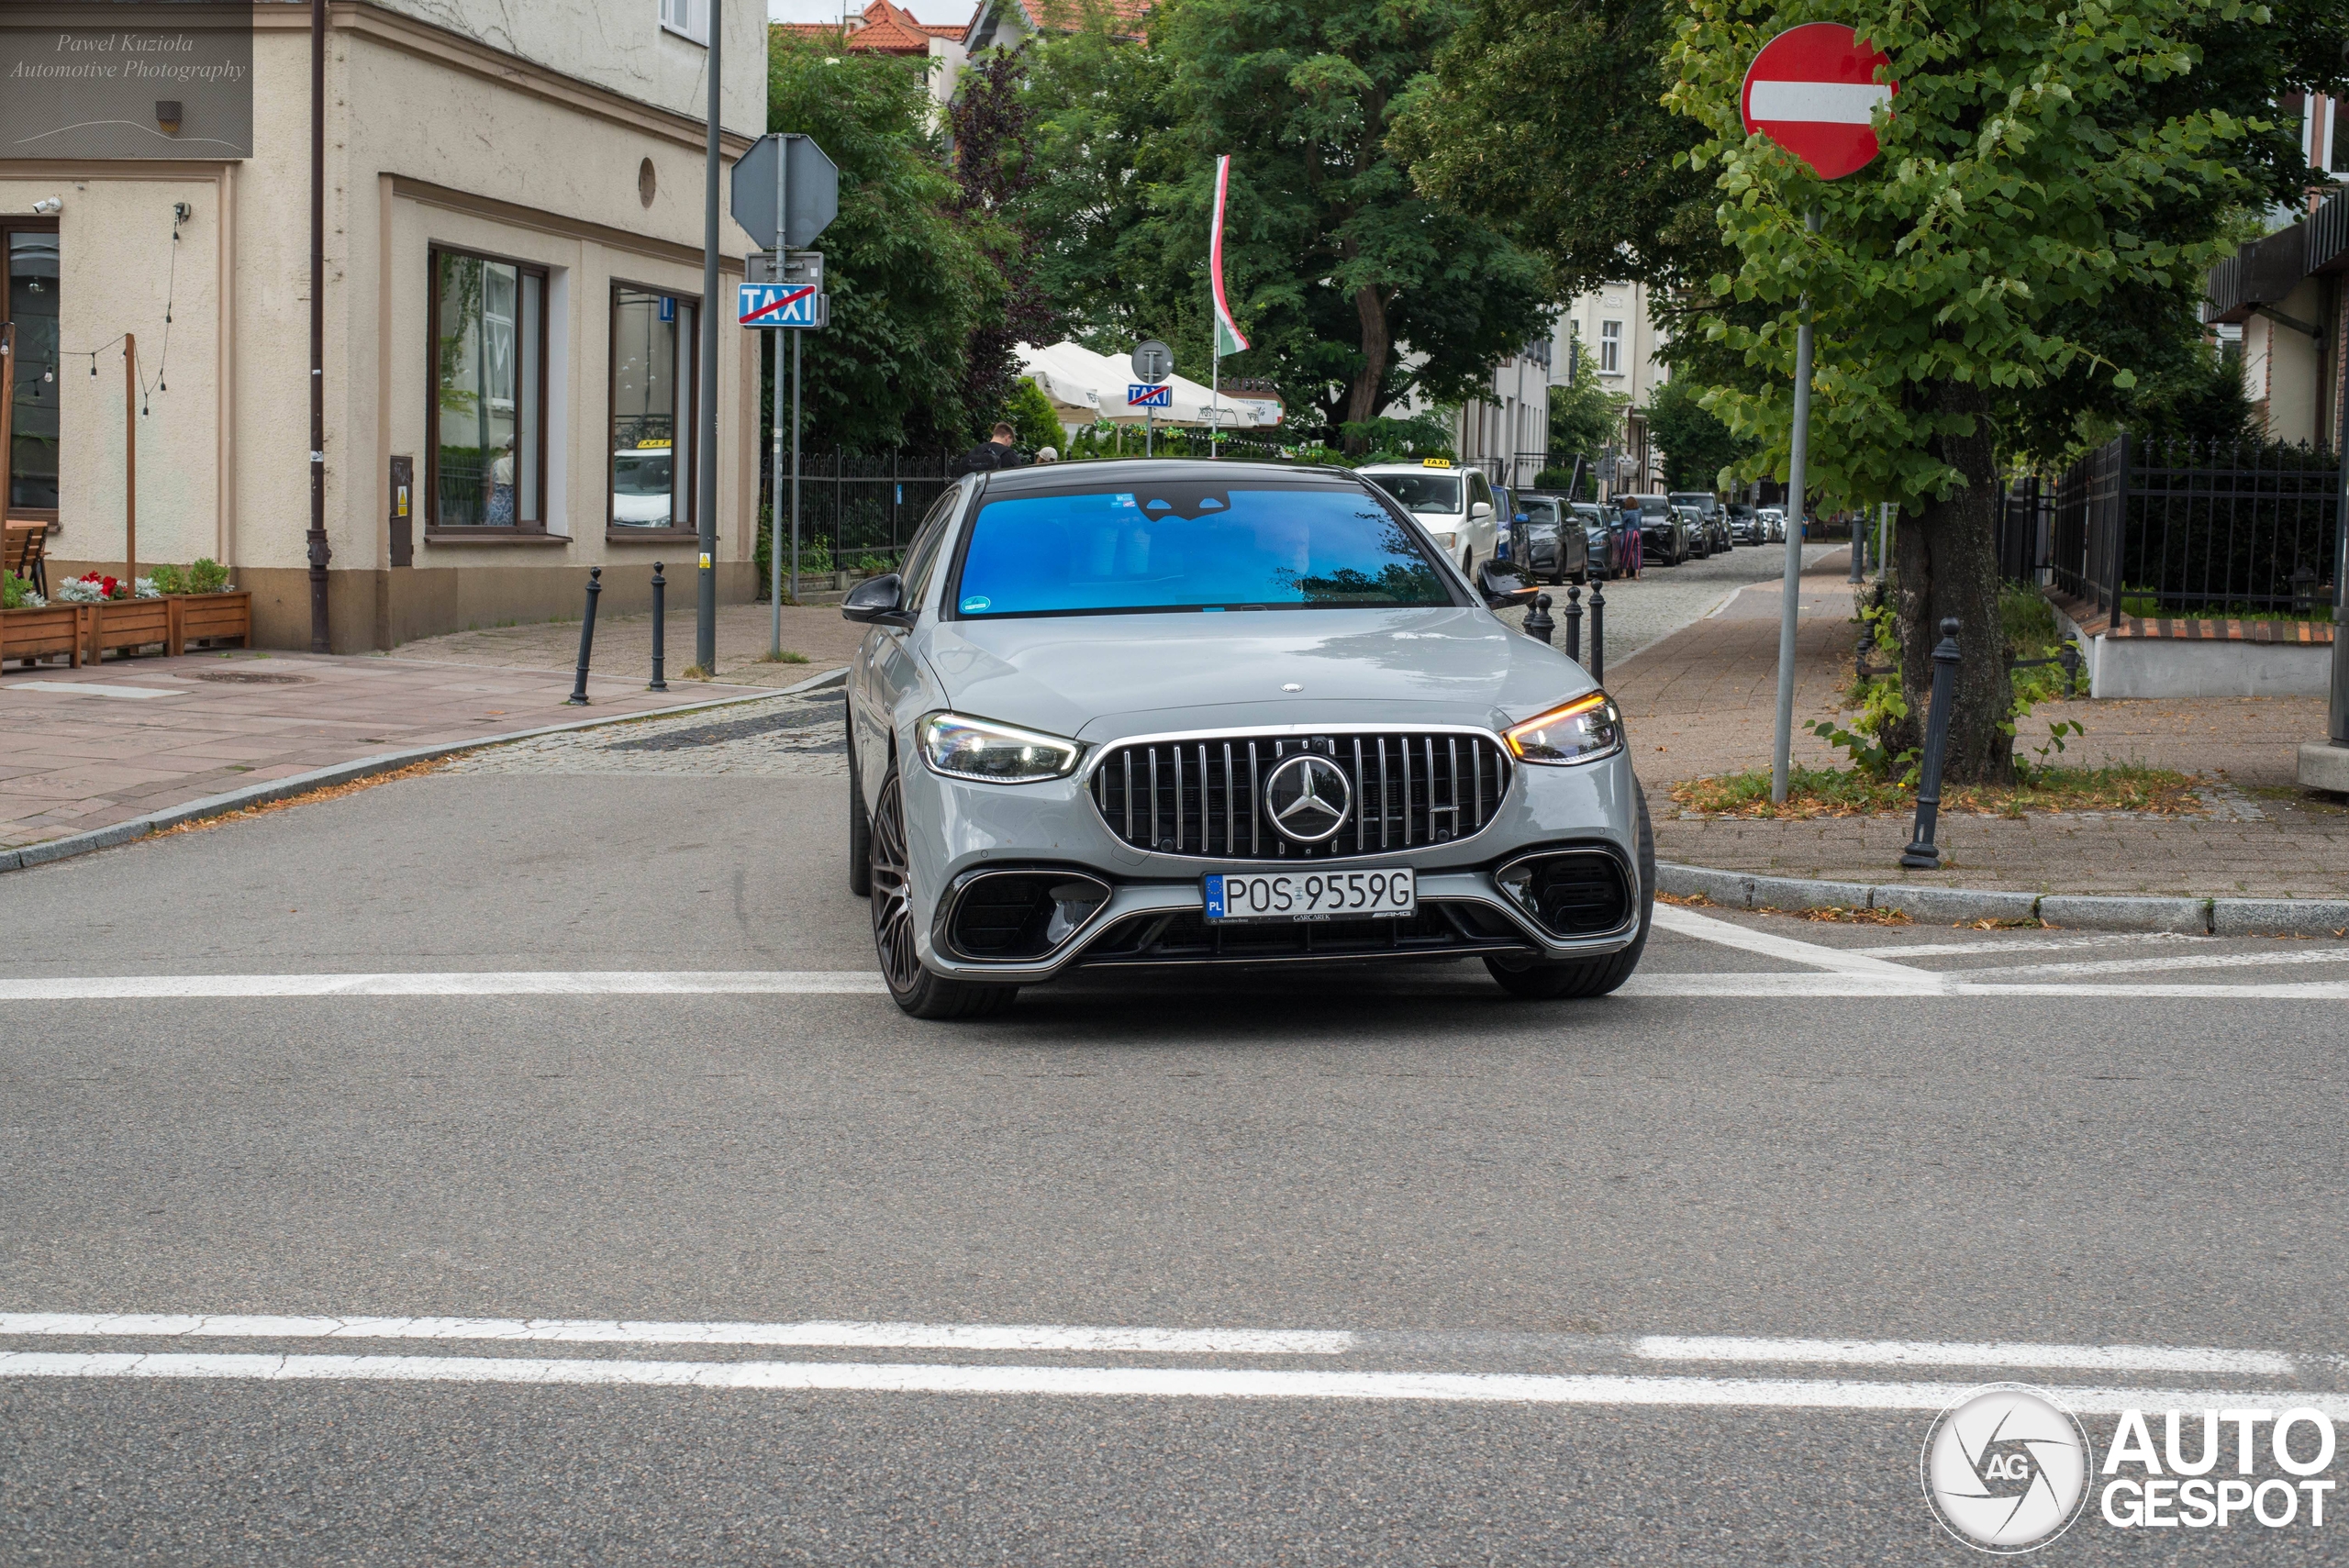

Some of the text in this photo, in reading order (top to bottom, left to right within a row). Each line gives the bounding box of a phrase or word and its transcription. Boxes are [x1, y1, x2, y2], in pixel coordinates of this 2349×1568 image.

[741, 288, 811, 321] TAXI
[1129, 386, 1168, 405] TAXI
[1226, 872, 1410, 914] POS 9559G
[1208, 901, 1222, 911] PL
[1293, 913, 1331, 922] GARCAREK
